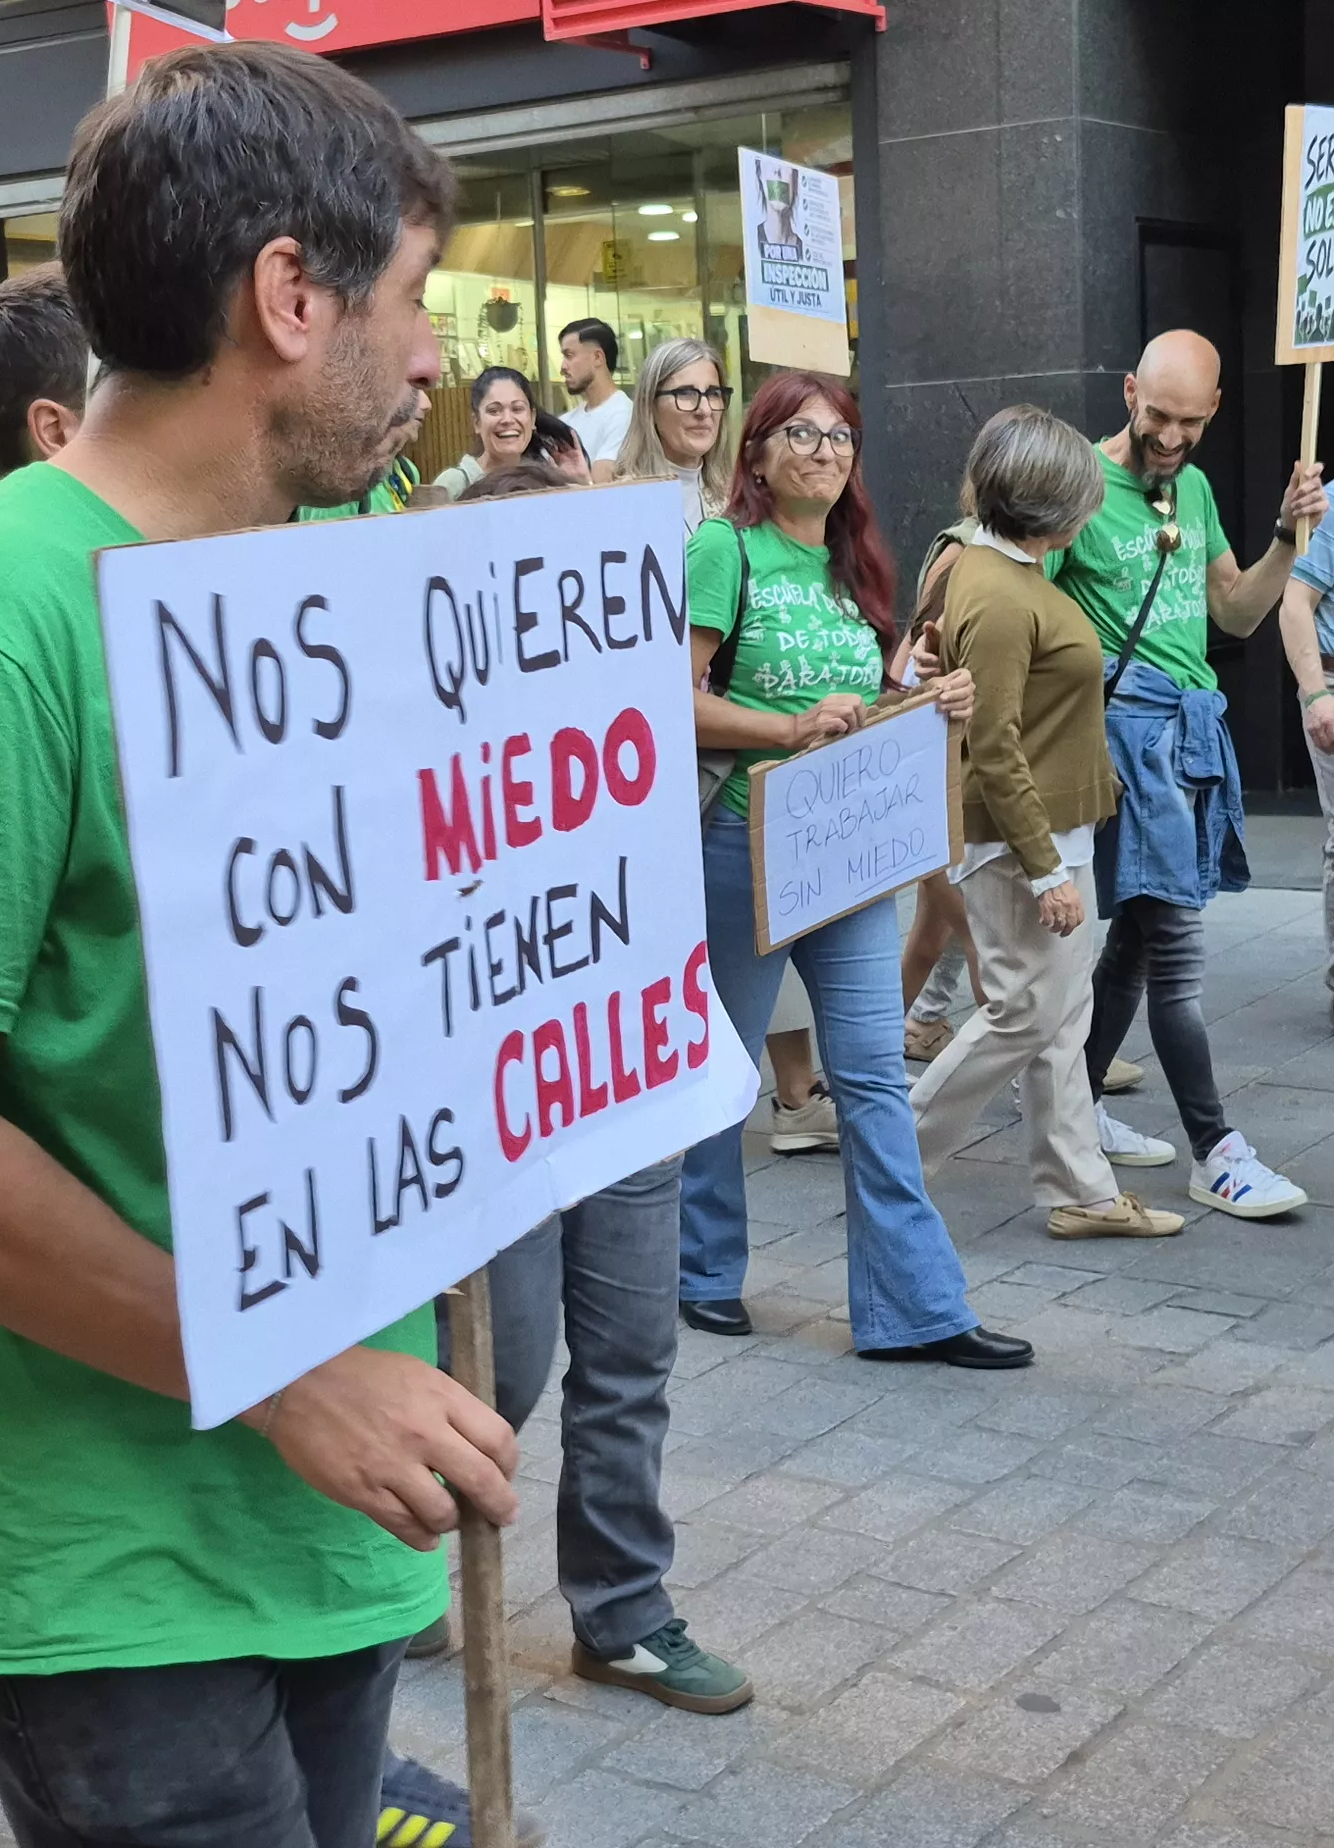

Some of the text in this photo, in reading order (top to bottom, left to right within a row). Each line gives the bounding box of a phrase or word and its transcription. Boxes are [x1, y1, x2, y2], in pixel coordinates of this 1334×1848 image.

[763, 243, 782, 260] POR
[1305, 199, 1324, 232] NO
[763, 262, 828, 291] INSPECCIÓN
[769, 285, 823, 309] ÚTIL Y JUSTA
[777, 629, 810, 652] DE
[153, 591, 355, 779] NOS
[785, 738, 901, 820] QUIERO
[786, 773, 924, 861] TRABAJAR
[223, 785, 356, 949] CON
[778, 827, 925, 917] SIN MIEDO
[208, 975, 379, 1143] NOS
[236, 939, 709, 1313] EN LAS CALLES
